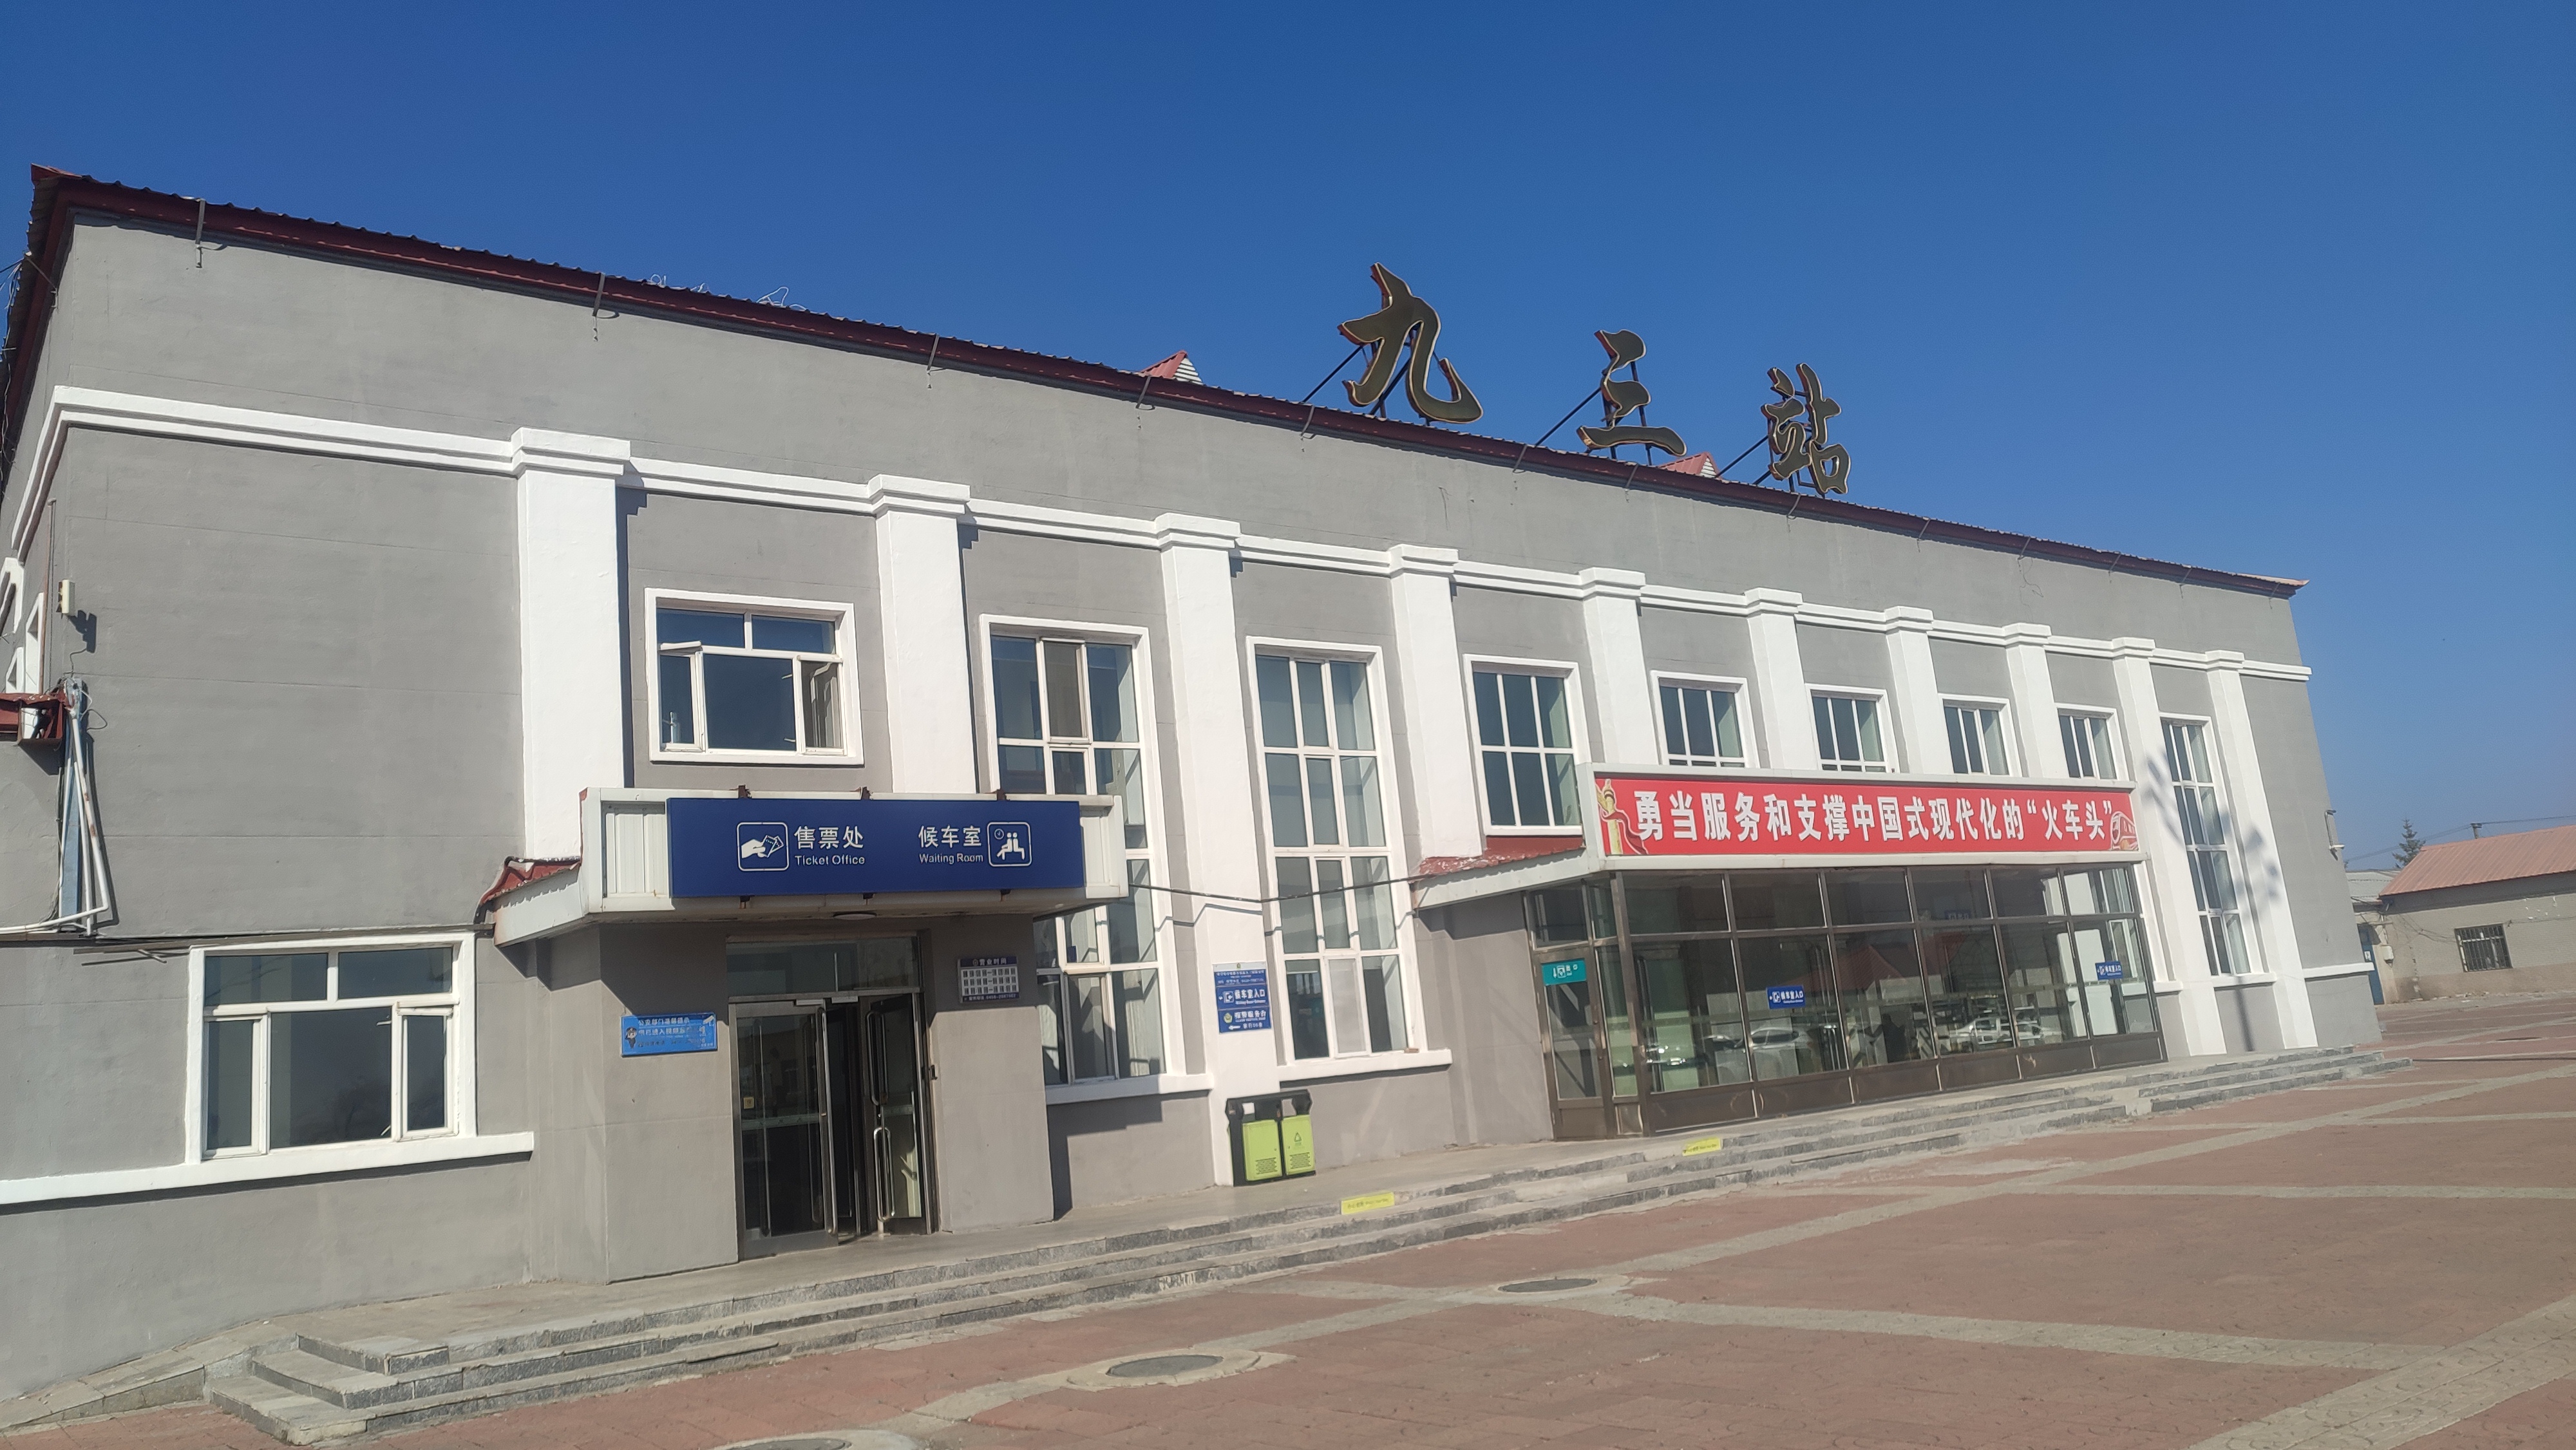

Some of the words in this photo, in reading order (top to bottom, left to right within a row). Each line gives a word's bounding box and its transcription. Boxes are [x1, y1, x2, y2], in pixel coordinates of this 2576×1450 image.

[1337, 262, 1852, 494] 九三站
[1634, 791, 2112, 842] 勇当服务和支撑中国式现代化的“火车头”
[794, 825, 864, 850] 售票处
[918, 824, 982, 848] 候车室
[794, 855, 829, 866] Ticket
[832, 854, 865, 865] Office
[919, 853, 954, 864] Waiting
[957, 853, 983, 862] Room
